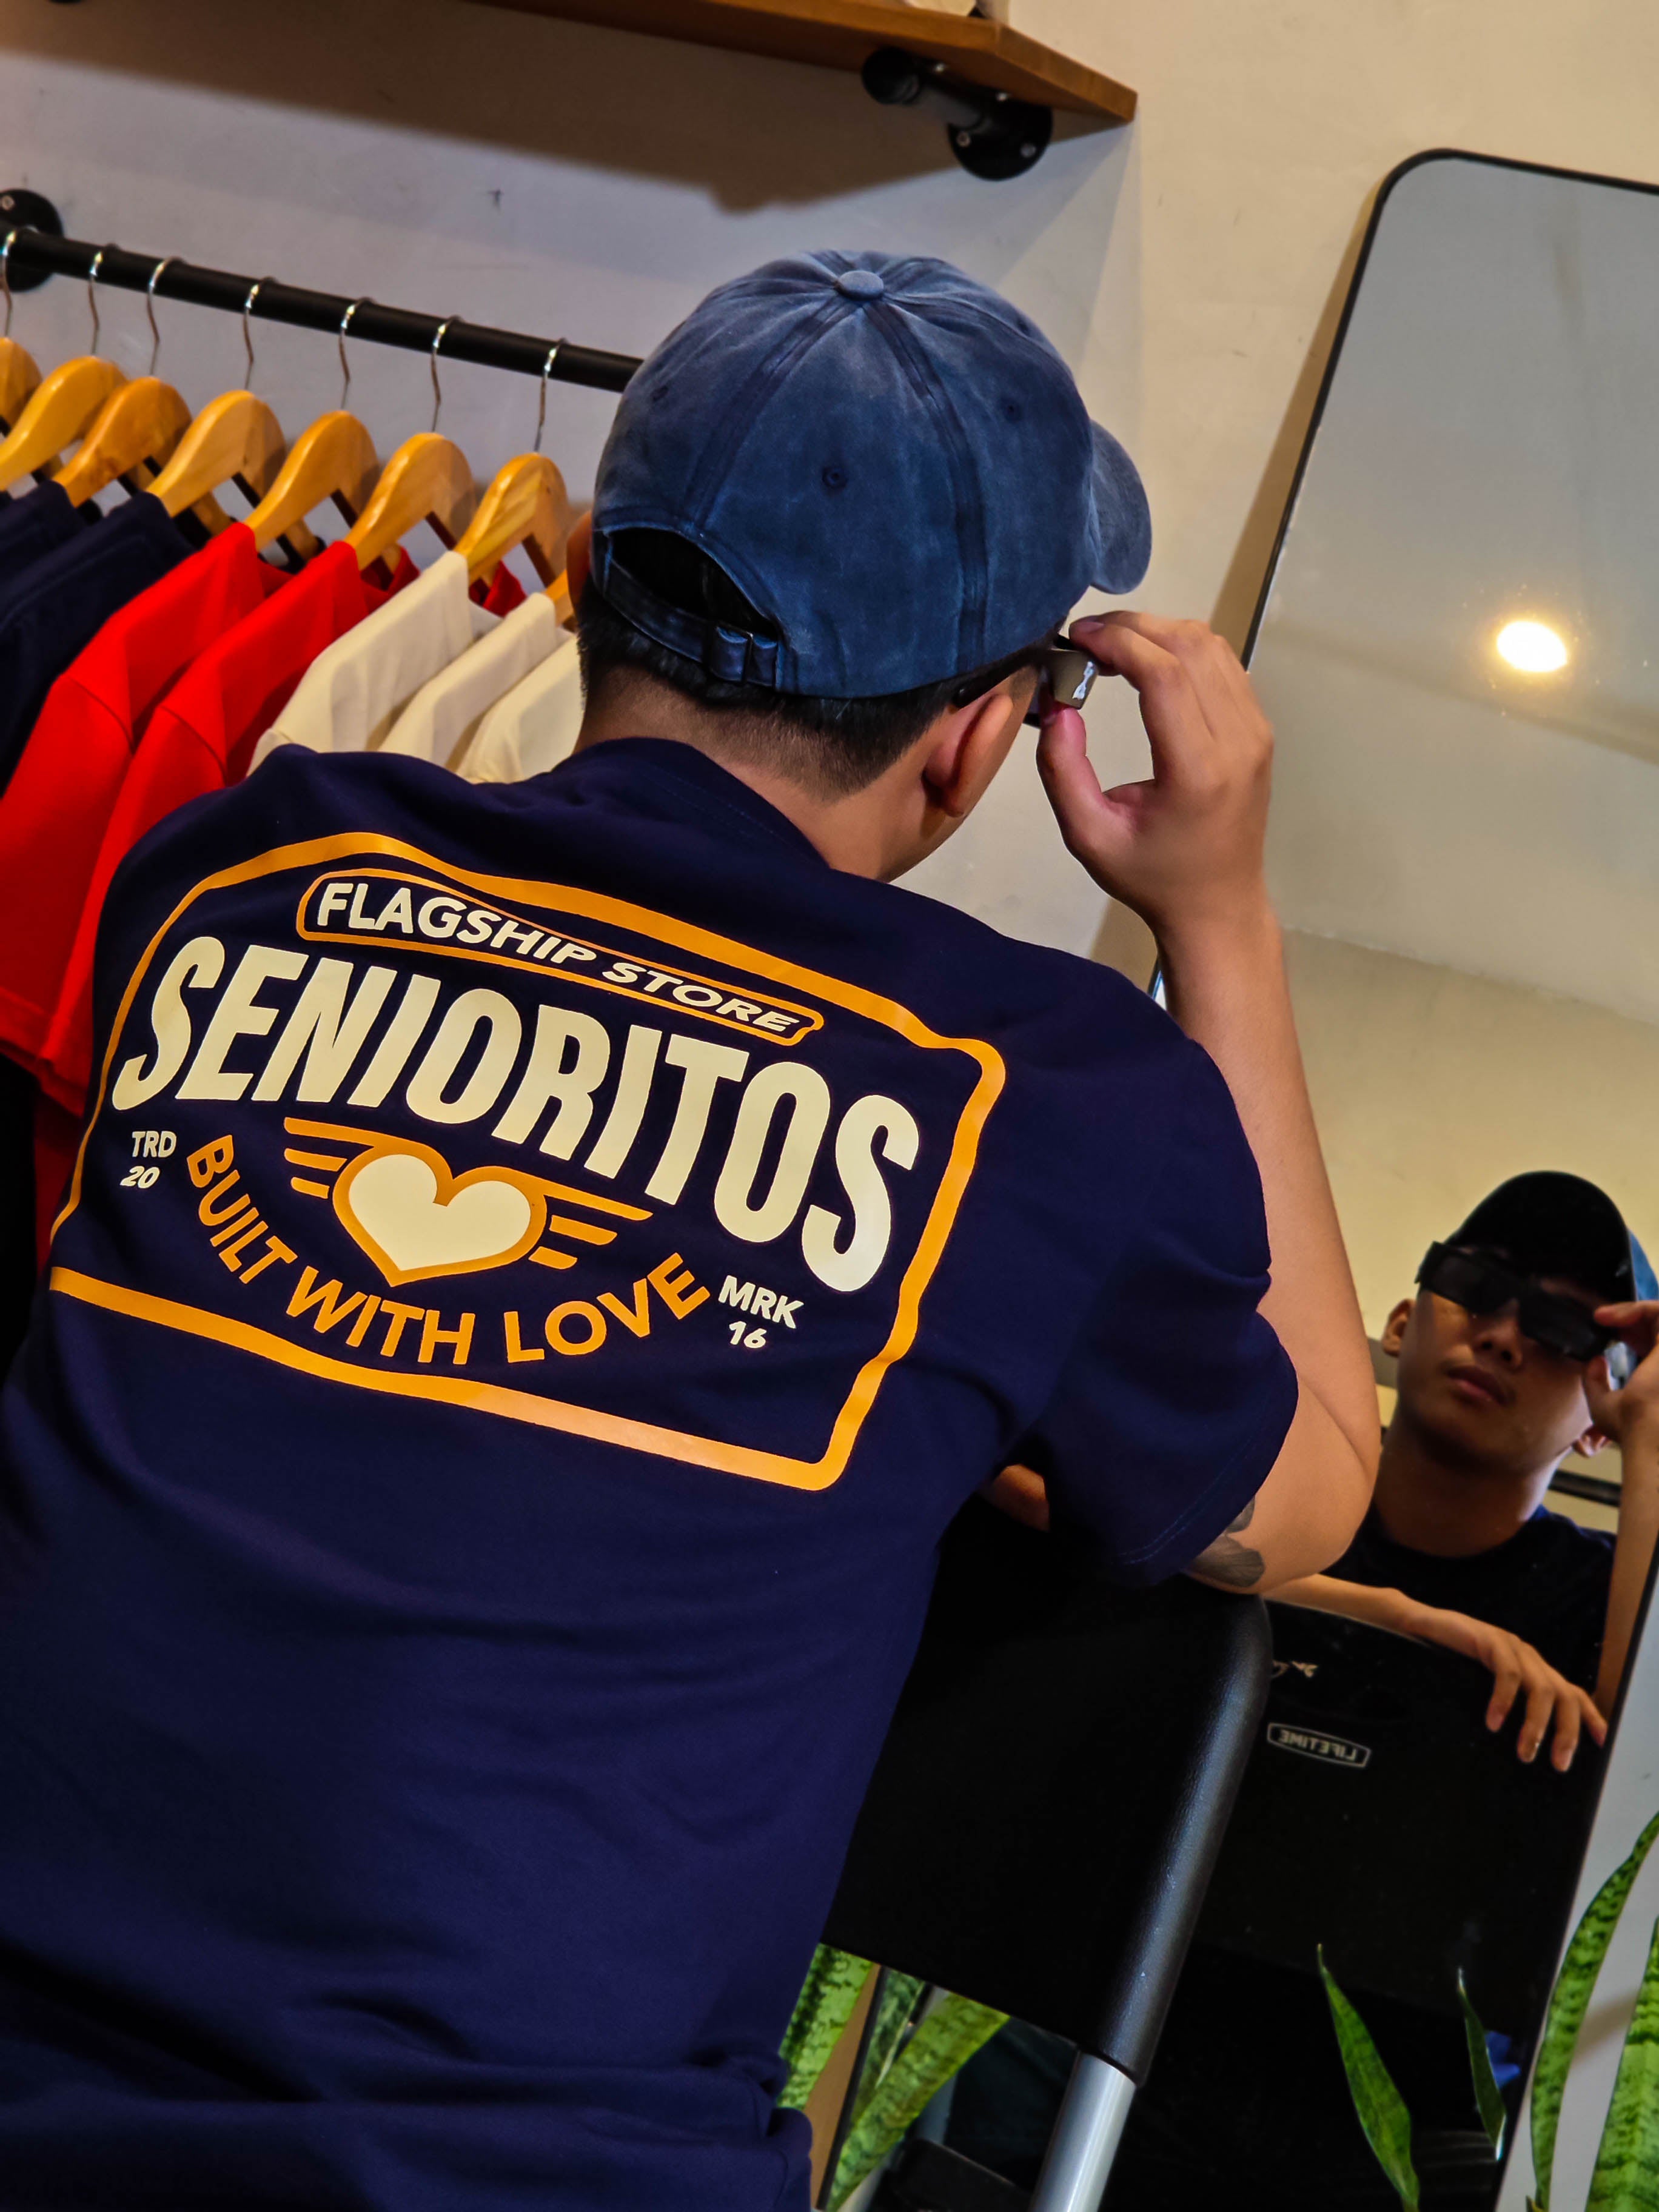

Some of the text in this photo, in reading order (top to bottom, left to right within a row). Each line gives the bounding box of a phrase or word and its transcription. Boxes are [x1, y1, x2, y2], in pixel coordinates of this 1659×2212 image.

[317, 883, 800, 1032] FLAGSHIP STORE
[112, 936, 919, 1292] SENIORITOS
[132, 1130, 176, 1158] TRD
[120, 1165, 159, 1188] 20
[187, 1134, 711, 1365] BUILT WITH LOVE
[719, 1275, 804, 1329] MRK
[729, 1321, 767, 1349] 16
